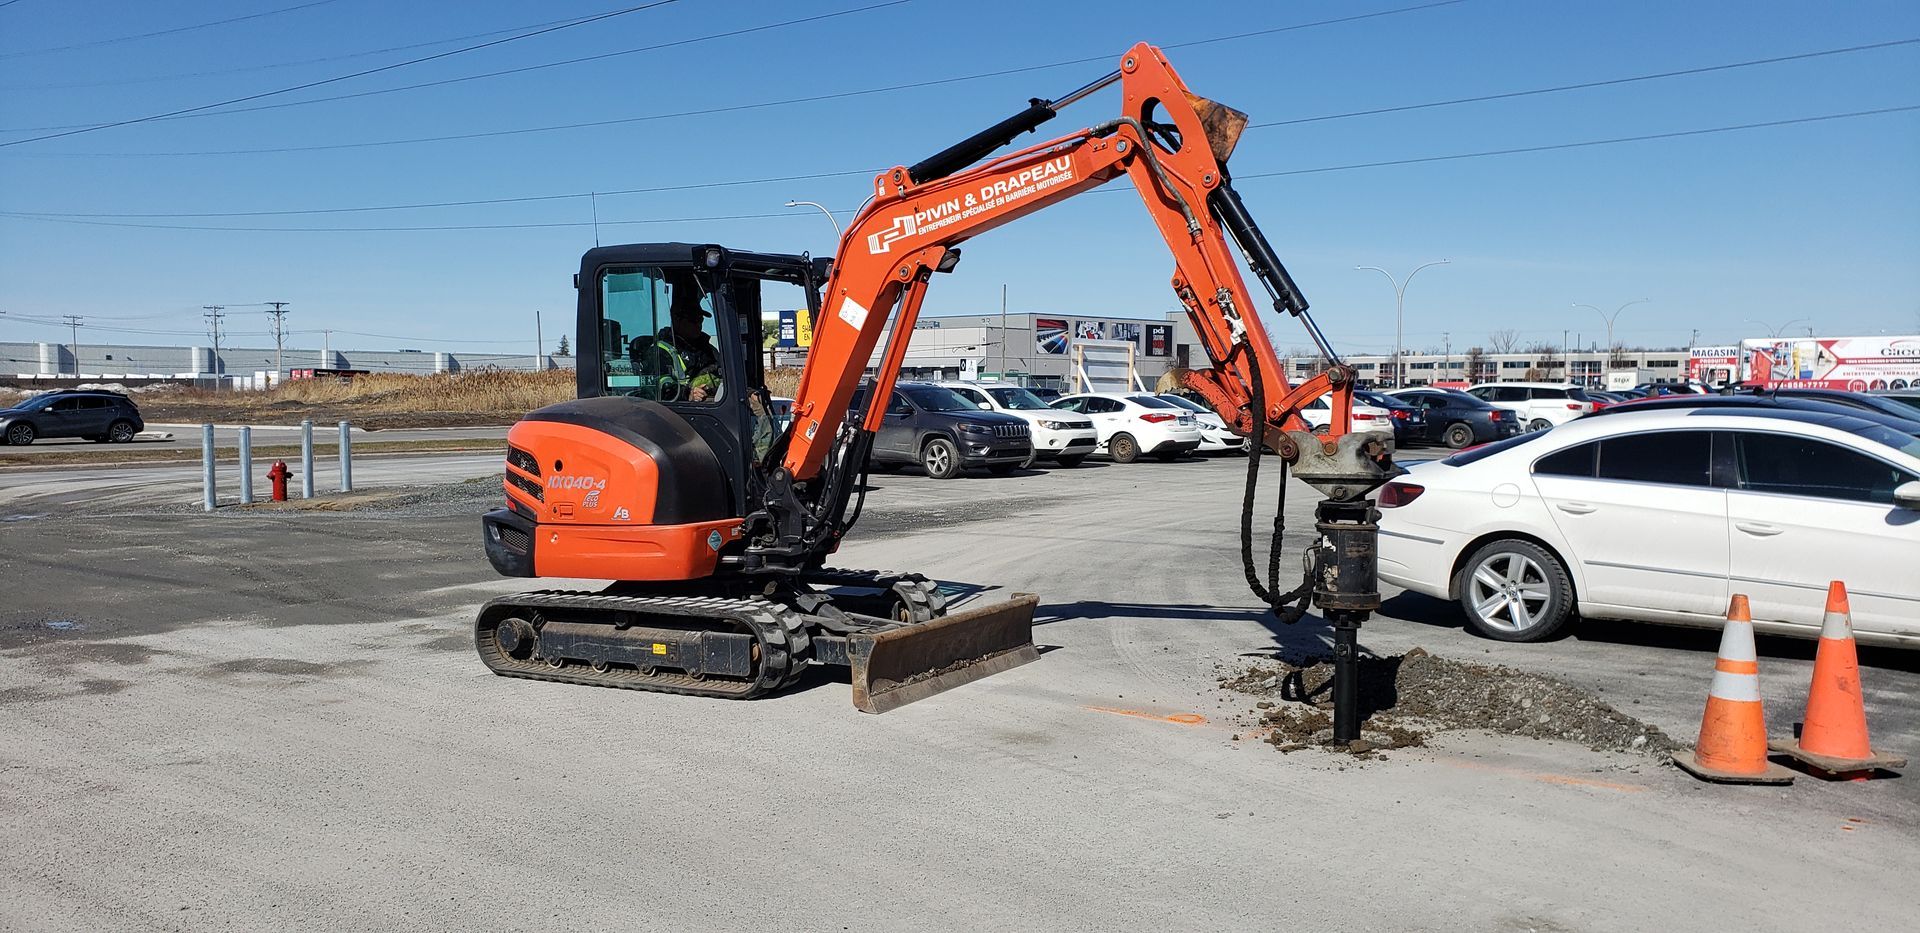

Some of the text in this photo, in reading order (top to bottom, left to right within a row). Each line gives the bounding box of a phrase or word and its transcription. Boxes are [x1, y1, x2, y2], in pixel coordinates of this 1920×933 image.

[915, 155, 1071, 226] PIVIN & DRAPEAU
[918, 213, 962, 236] ENTREPRENEUR
[962, 198, 996, 218] SPÉCIALISÉ
[996, 197, 1005, 207] EN
[1036, 170, 1073, 191] MOTORISÉE
[1692, 348, 1736, 357] MAGASIN
